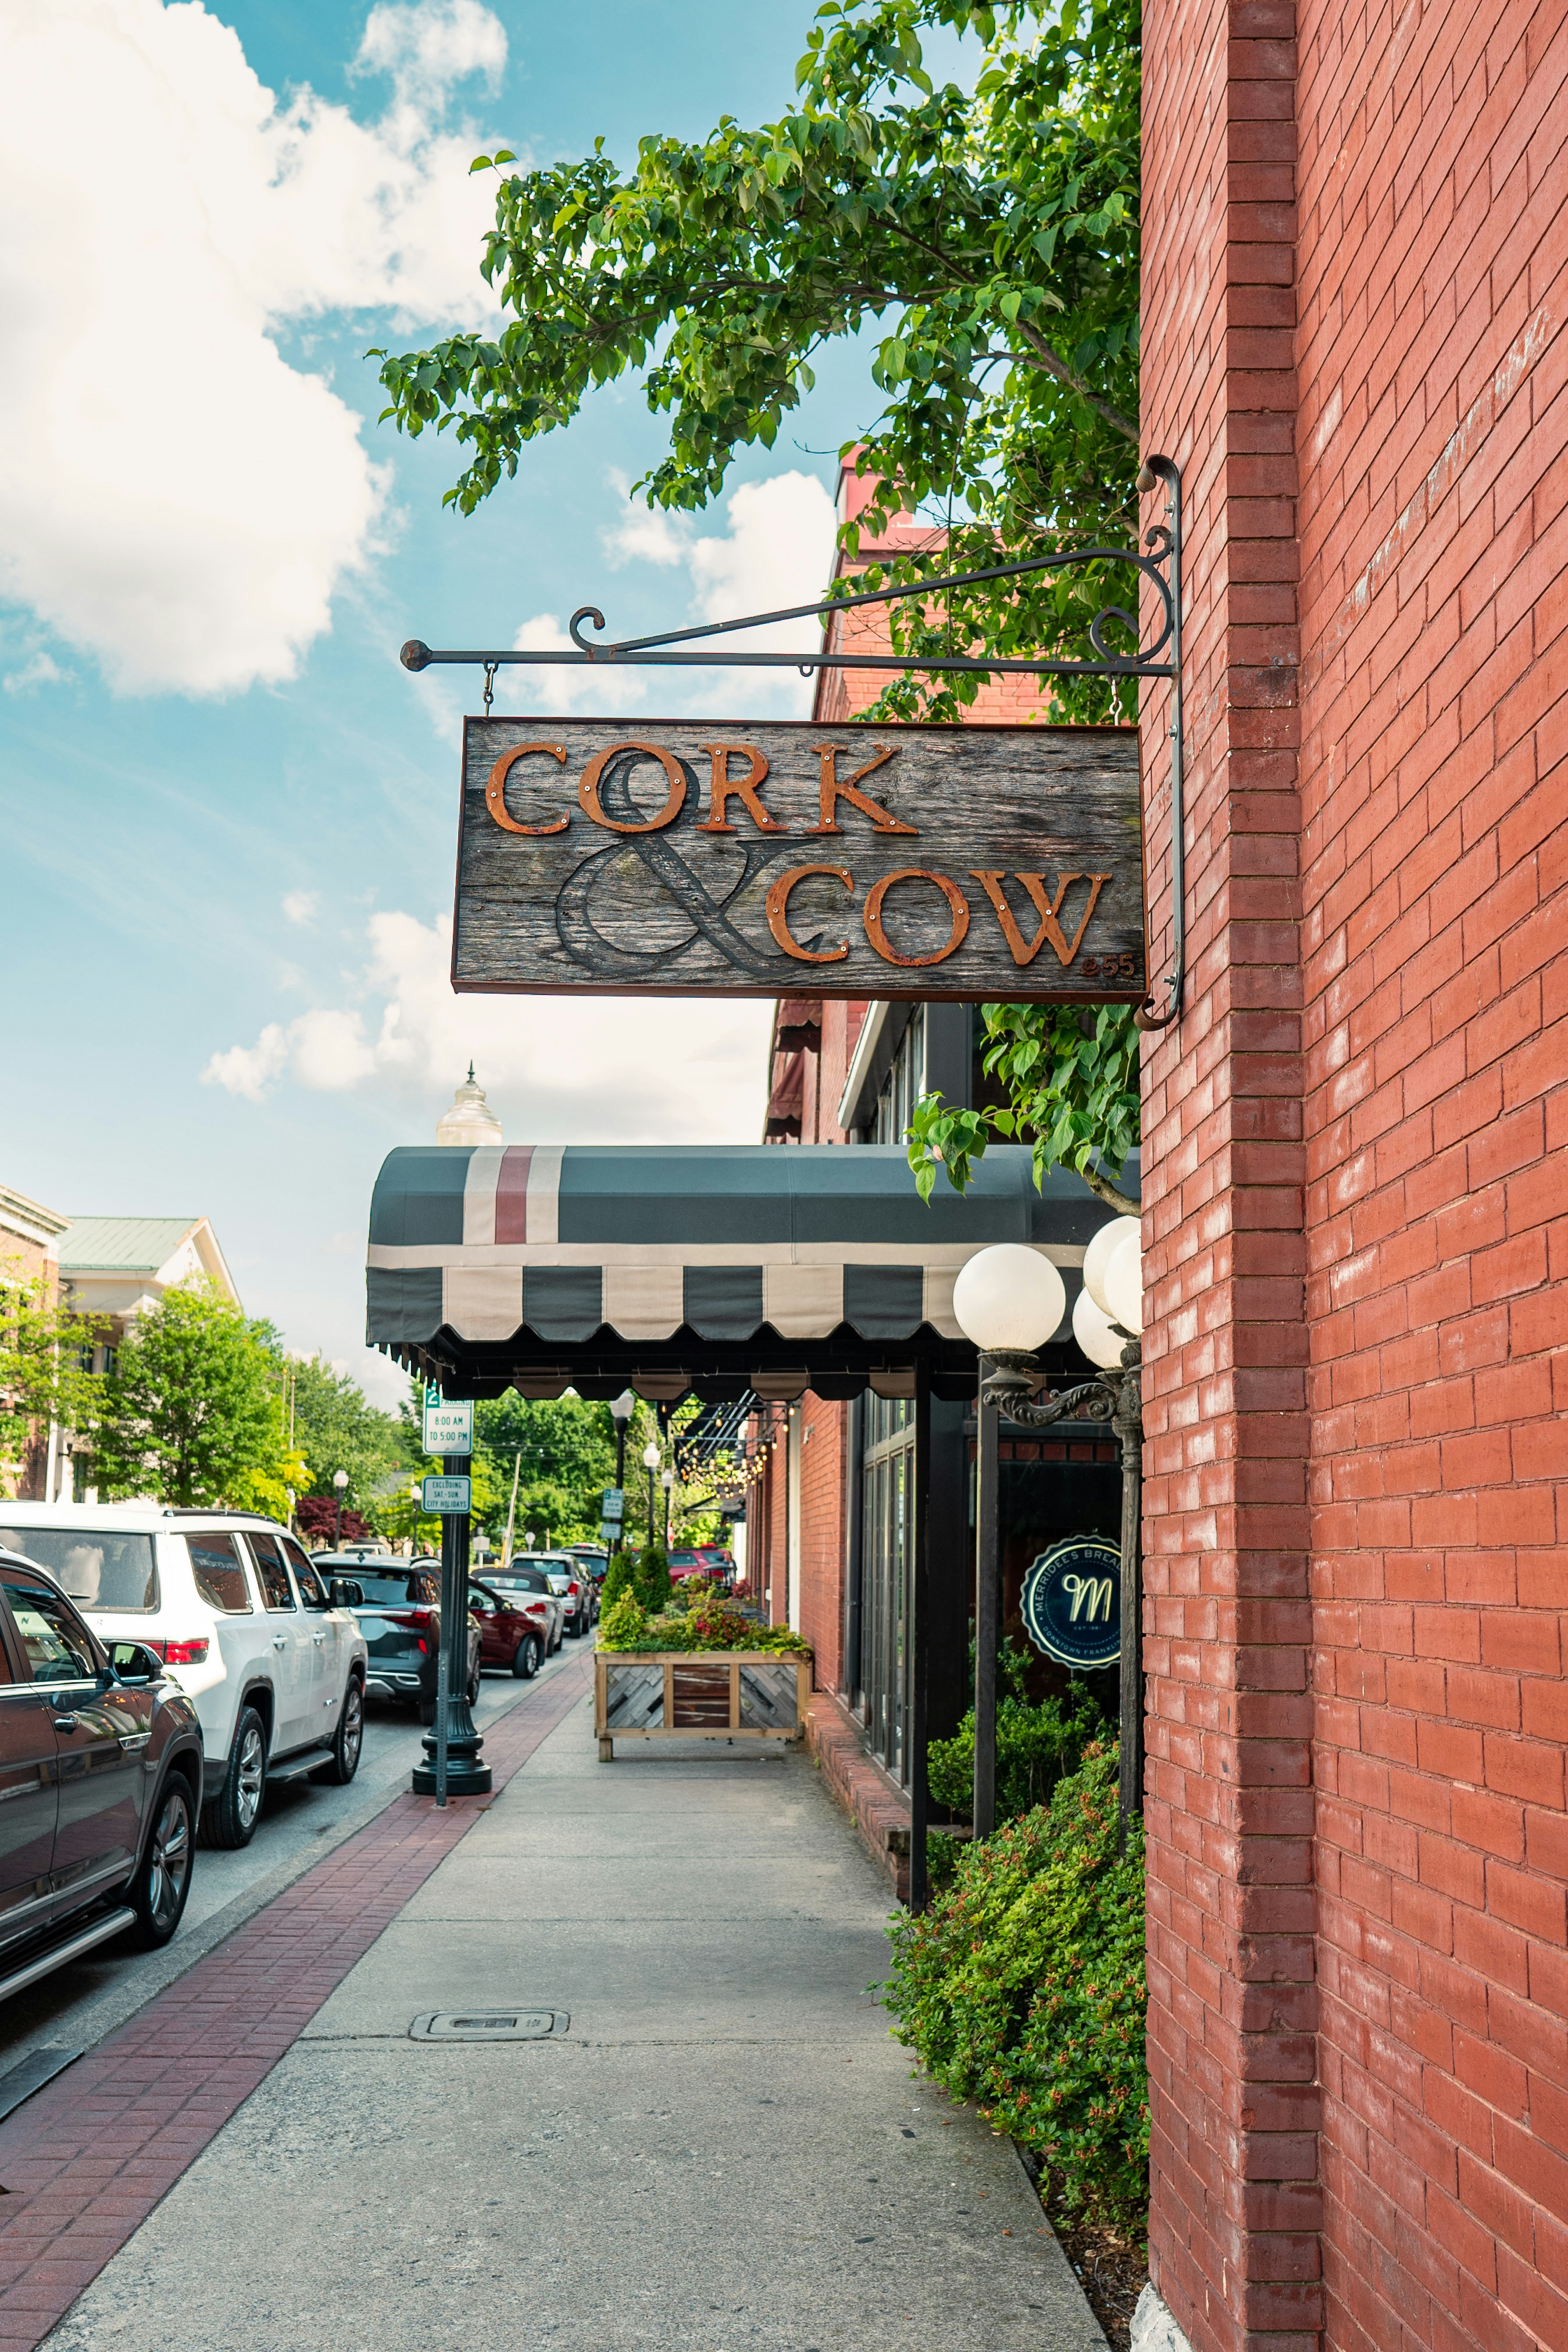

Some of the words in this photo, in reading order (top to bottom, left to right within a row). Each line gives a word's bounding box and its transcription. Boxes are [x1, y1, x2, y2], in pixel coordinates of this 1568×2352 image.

[485, 741, 918, 835] CORK
[556, 752, 820, 977] &
[765, 863, 1113, 966] COW
[430, 1431, 438, 1441] TO
[440, 1431, 456, 1441] 5:00
[458, 1432, 467, 1441] PM
[435, 1416, 451, 1425] 8:00
[453, 1416, 463, 1425] AM
[1035, 1551, 1079, 1612] MERRIDEE'S
[1042, 1626, 1080, 1655] DOWNTOWN
